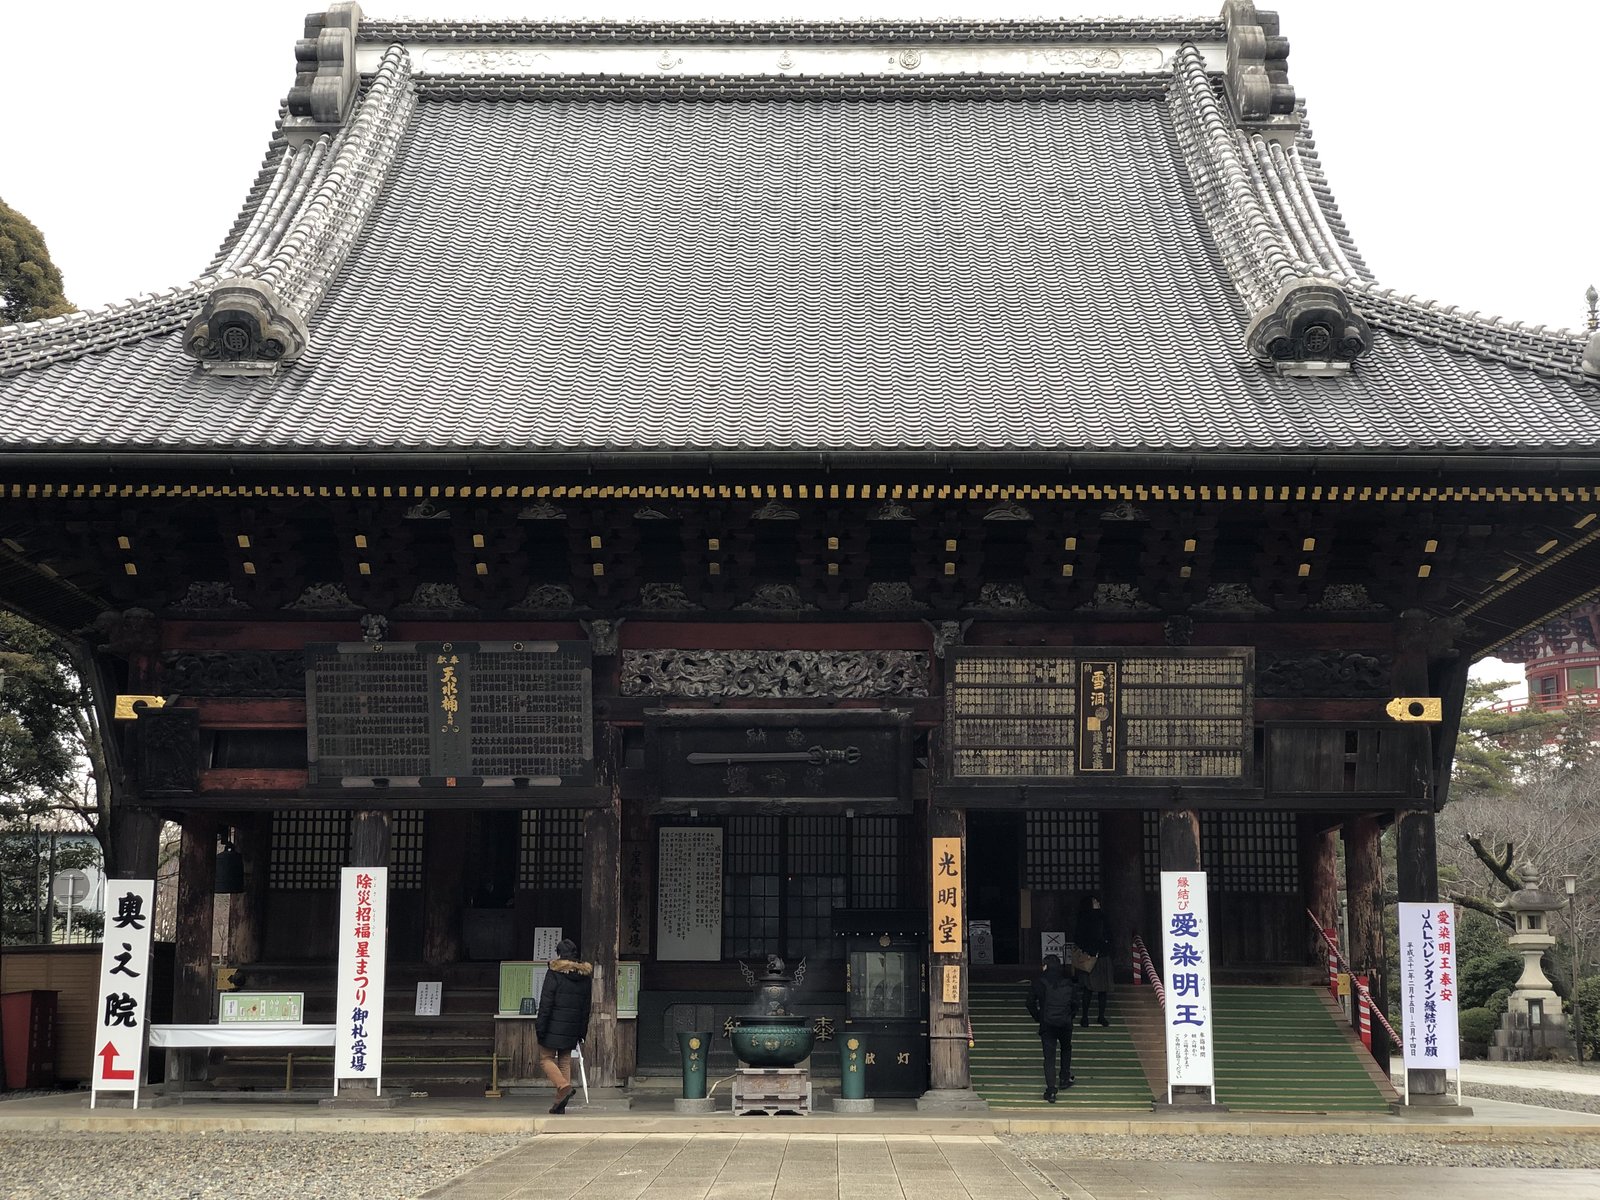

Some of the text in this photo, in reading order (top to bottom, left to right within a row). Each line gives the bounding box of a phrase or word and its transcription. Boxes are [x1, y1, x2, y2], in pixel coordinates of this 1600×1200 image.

[441, 667, 457, 711] 天水桶
[1091, 671, 1106, 705] 雪洞
[938, 851, 958, 944] 光明堂
[1177, 876, 1189, 910] 縁結び
[104, 891, 146, 1027] 奥之院
[350, 874, 372, 1072] 除災招福星まつり御札受場
[1169, 913, 1203, 1026] 愛染明王
[1422, 909, 1438, 1058] JALバレンタイン縁結び祈願
[1438, 910, 1452, 1001] 愛染明王奉安
